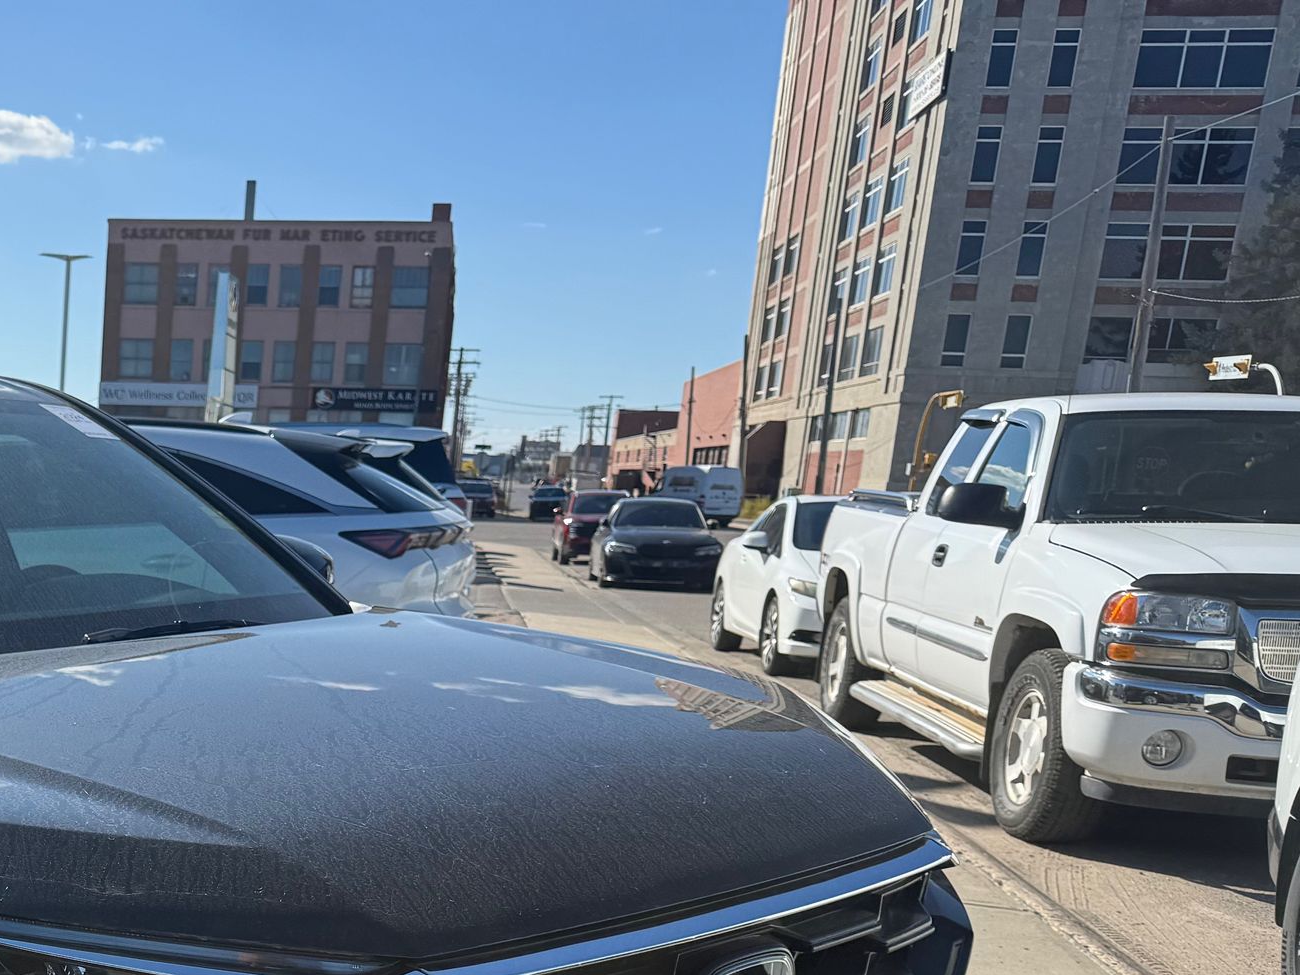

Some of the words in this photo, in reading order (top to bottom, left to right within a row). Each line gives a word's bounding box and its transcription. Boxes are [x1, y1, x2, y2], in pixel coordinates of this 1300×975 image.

[120, 227, 235, 241] SASKATCHEWAN
[242, 229, 272, 241] FUR
[280, 229, 311, 242] MAR
[320, 230, 366, 242] ETING
[374, 230, 437, 243] SERVICE
[129, 389, 173, 401] Wellness
[337, 389, 384, 401] MIDWEST
[1136, 456, 1168, 470] STOP
